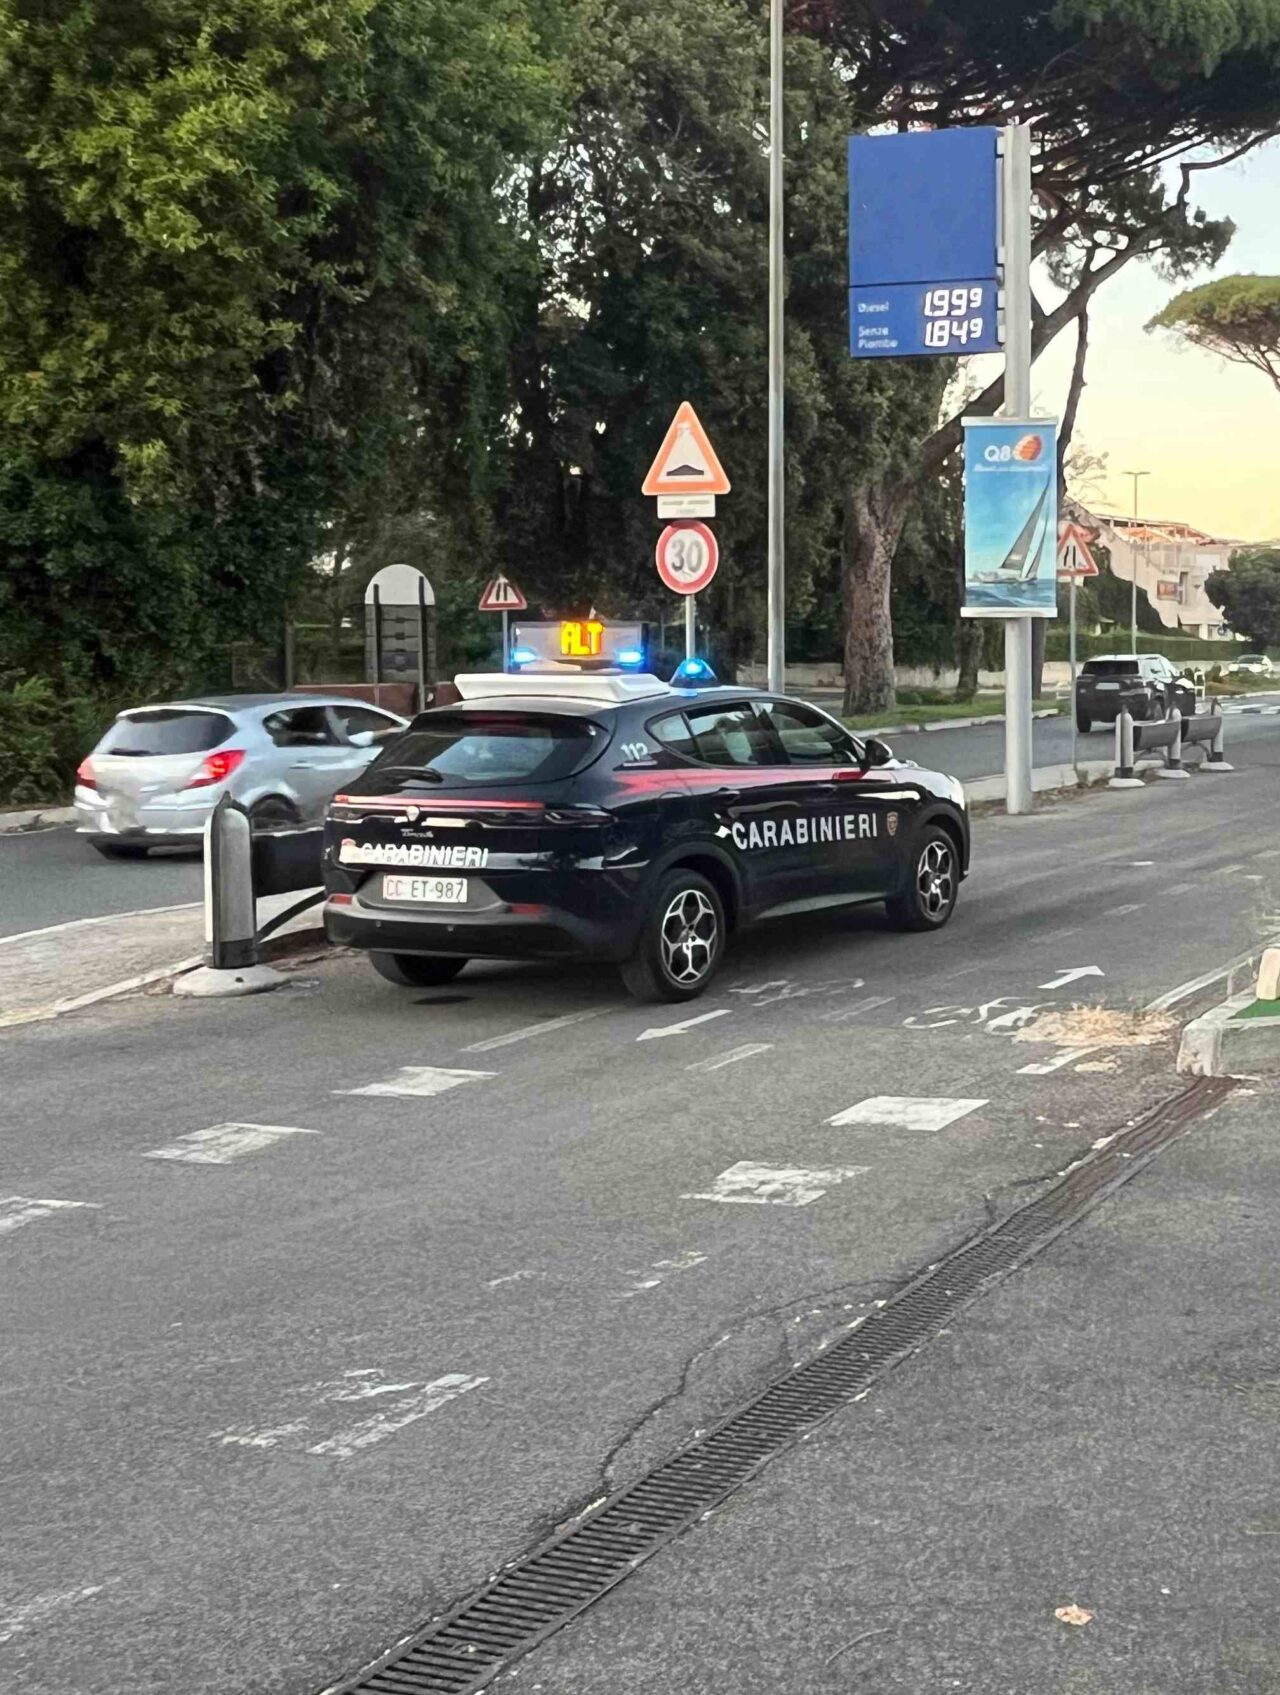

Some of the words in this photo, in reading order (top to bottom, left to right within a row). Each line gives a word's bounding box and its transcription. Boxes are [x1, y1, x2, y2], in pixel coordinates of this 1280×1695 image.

[984, 445, 1011, 463] Q8
[671, 538, 703, 573] 30
[561, 621, 603, 655] ALT
[732, 812, 878, 850] CARABINIERI
[362, 843, 488, 867] CARABINIERI
